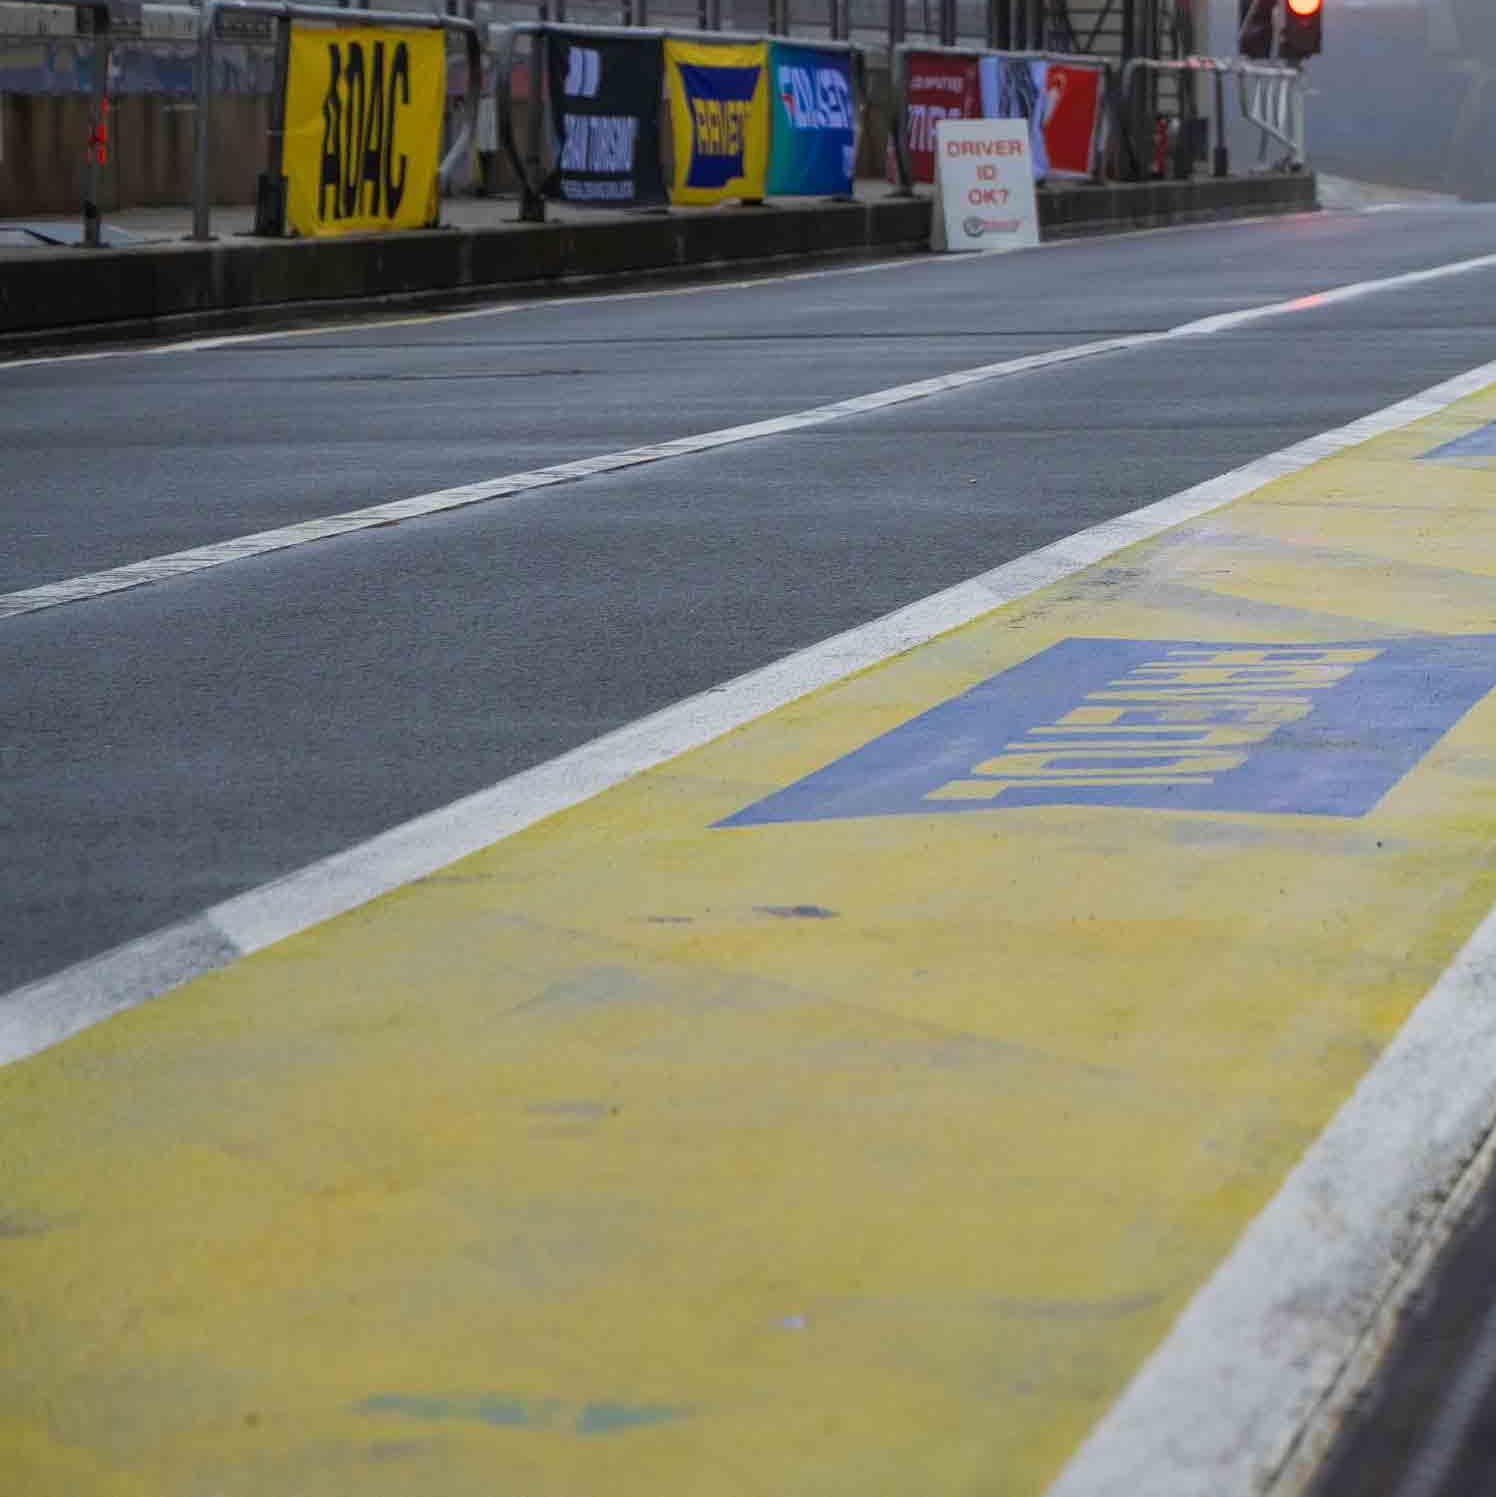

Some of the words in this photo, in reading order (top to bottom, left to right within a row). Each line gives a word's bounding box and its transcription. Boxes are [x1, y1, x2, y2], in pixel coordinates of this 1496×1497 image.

[318, 40, 411, 223] ADAC
[945, 140, 1024, 157] DRIVER
[976, 165, 996, 181] ID
[968, 188, 1009, 205] OK?
